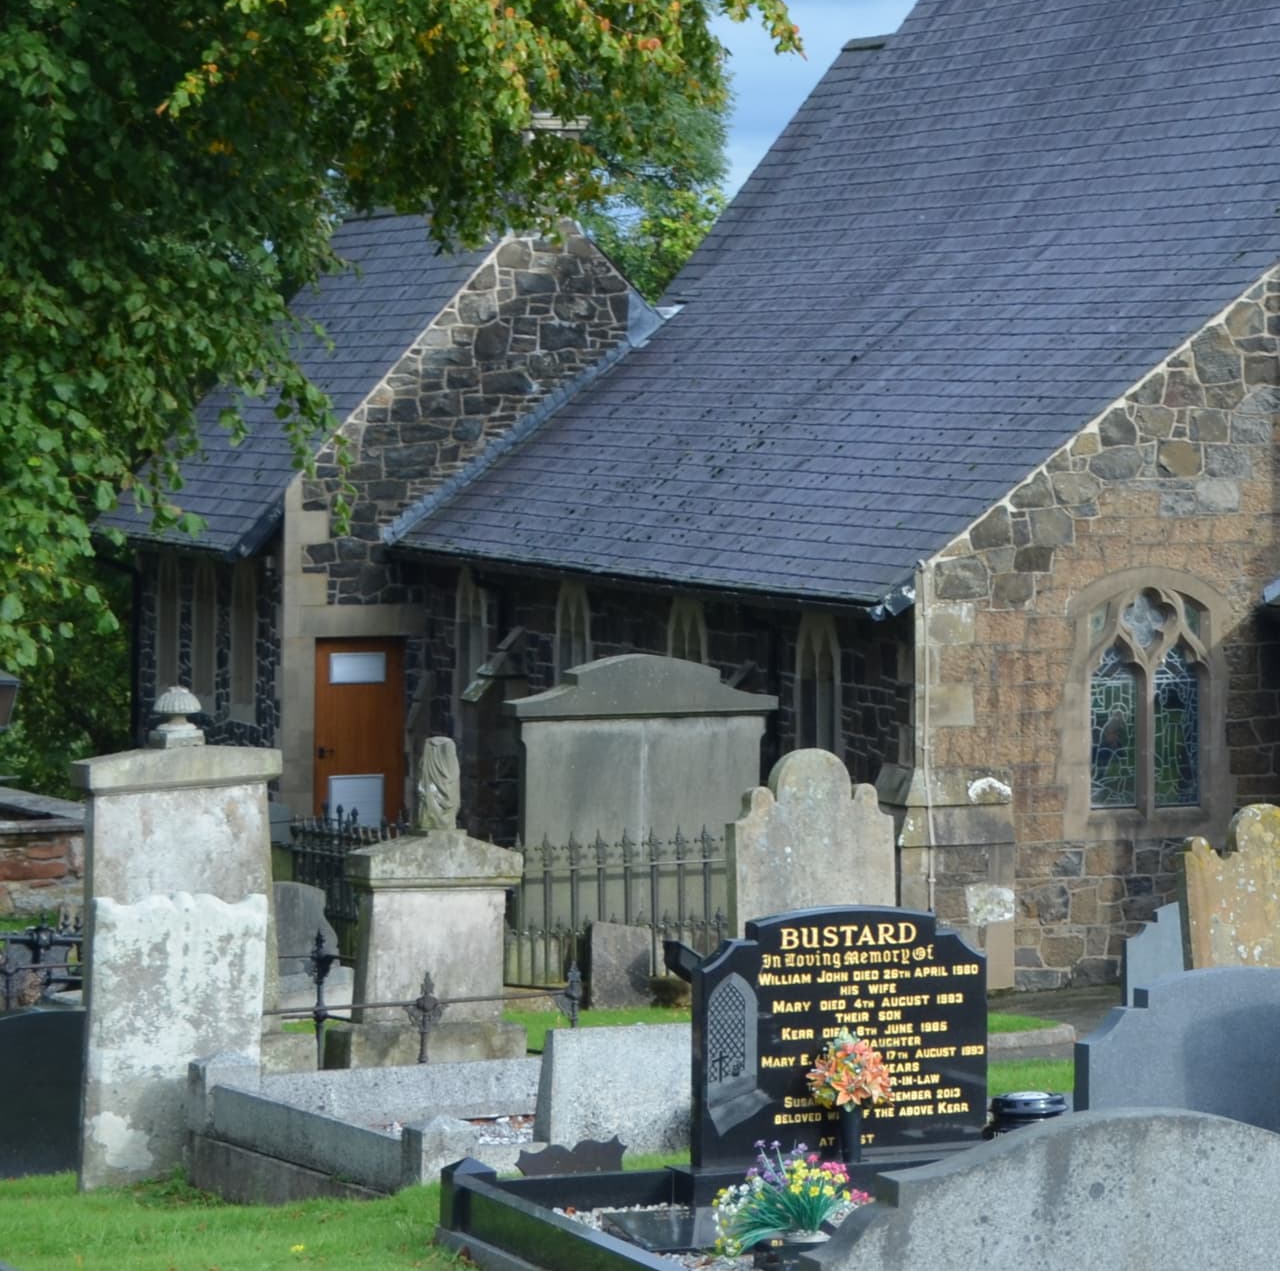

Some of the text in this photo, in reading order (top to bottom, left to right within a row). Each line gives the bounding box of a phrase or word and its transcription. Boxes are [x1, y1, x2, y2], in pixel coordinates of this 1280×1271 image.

[780, 922, 917, 950] BUSTARD
[762, 954, 781, 968] In
[785, 950, 841, 968] Loving
[844, 949, 910, 965] Memory
[759, 973, 812, 986] WILLIAM
[817, 970, 848, 983] JOHN
[853, 970, 879, 981] DIED
[914, 967, 948, 977] APRIL
[840, 983, 896, 995] HIS WIFE
[773, 995, 929, 1013] MARY DIED 4TH AUGUST
[835, 1010, 901, 1023] THEIR SON
[782, 1028, 814, 1040] KERR
[884, 1024, 913, 1034] JUNE
[761, 1056, 795, 1068] MARY
[915, 1048, 957, 1058] AUGUST
[937, 1088, 961, 1098] 2013
[774, 1102, 969, 1124] BELOVED THE ABOVE KERR
[819, 1136, 836, 1147] AT
